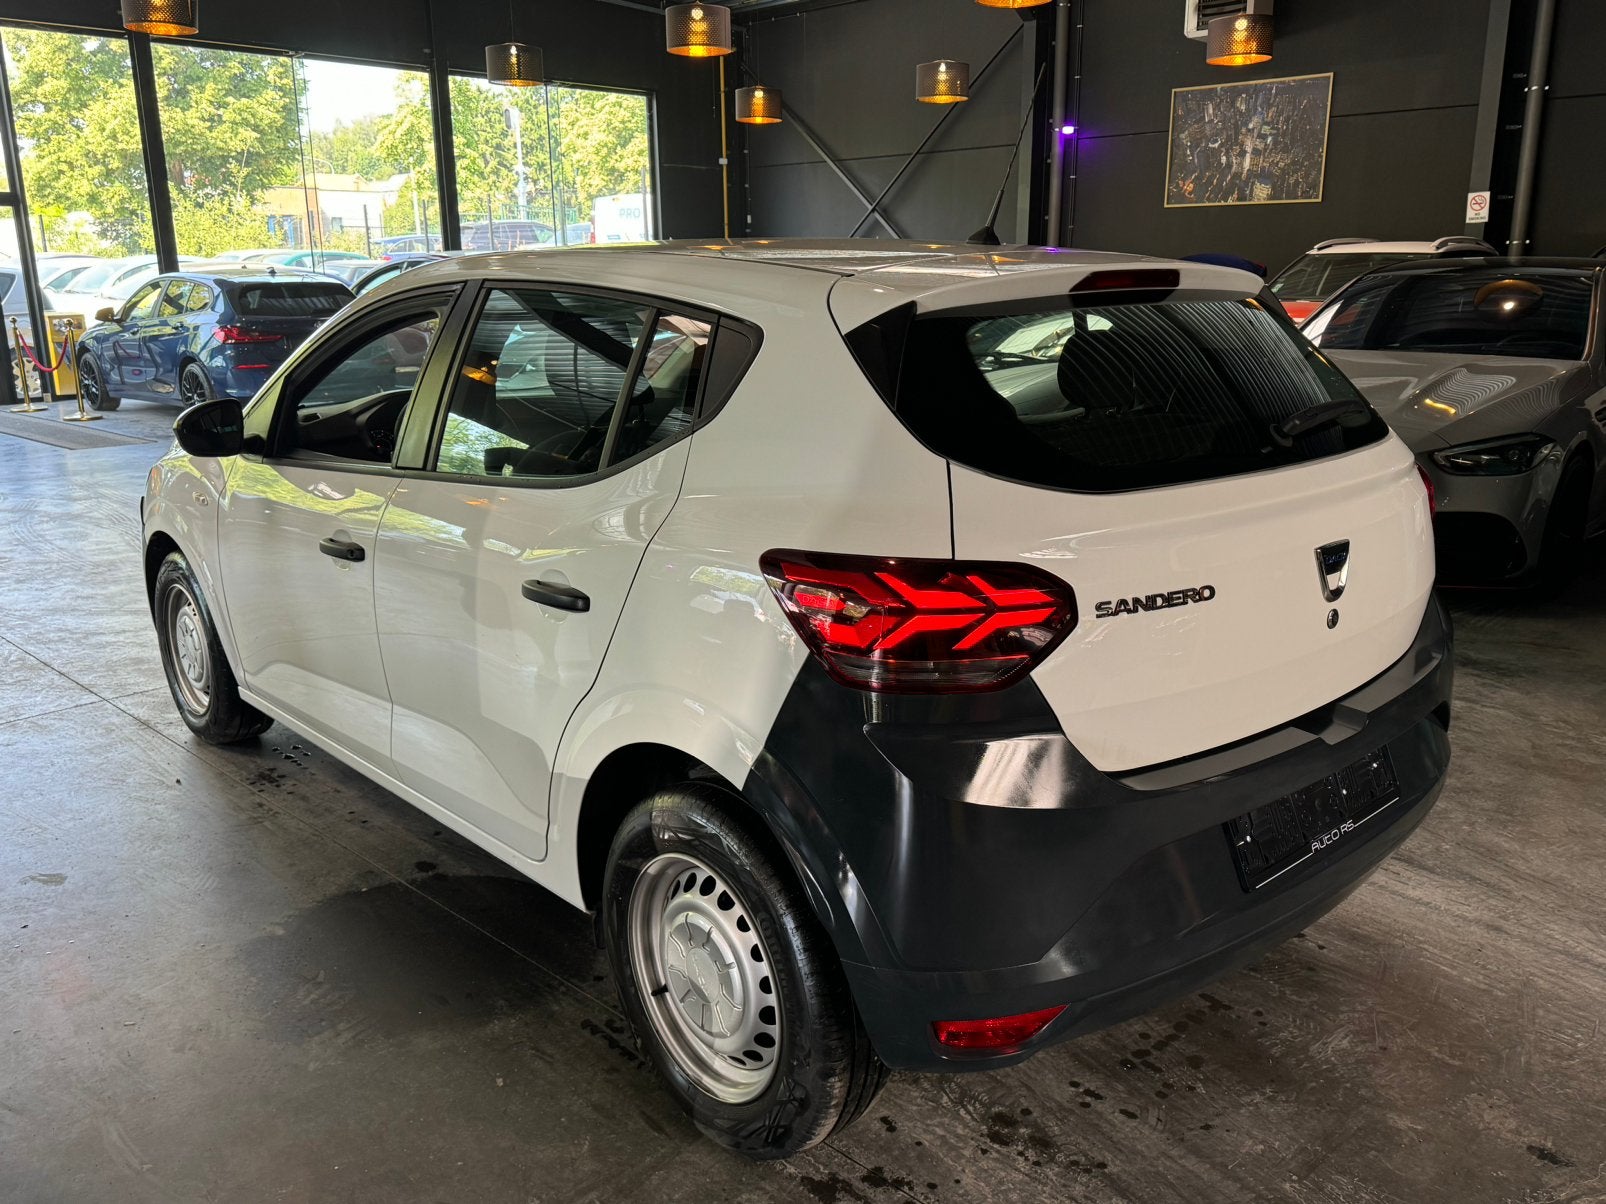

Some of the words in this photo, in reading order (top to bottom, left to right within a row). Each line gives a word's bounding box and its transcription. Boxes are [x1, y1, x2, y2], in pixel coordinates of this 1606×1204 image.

[619, 207, 641, 219] PRO
[1095, 585, 1216, 619] SANDERO
[1340, 819, 1355, 835] RS
